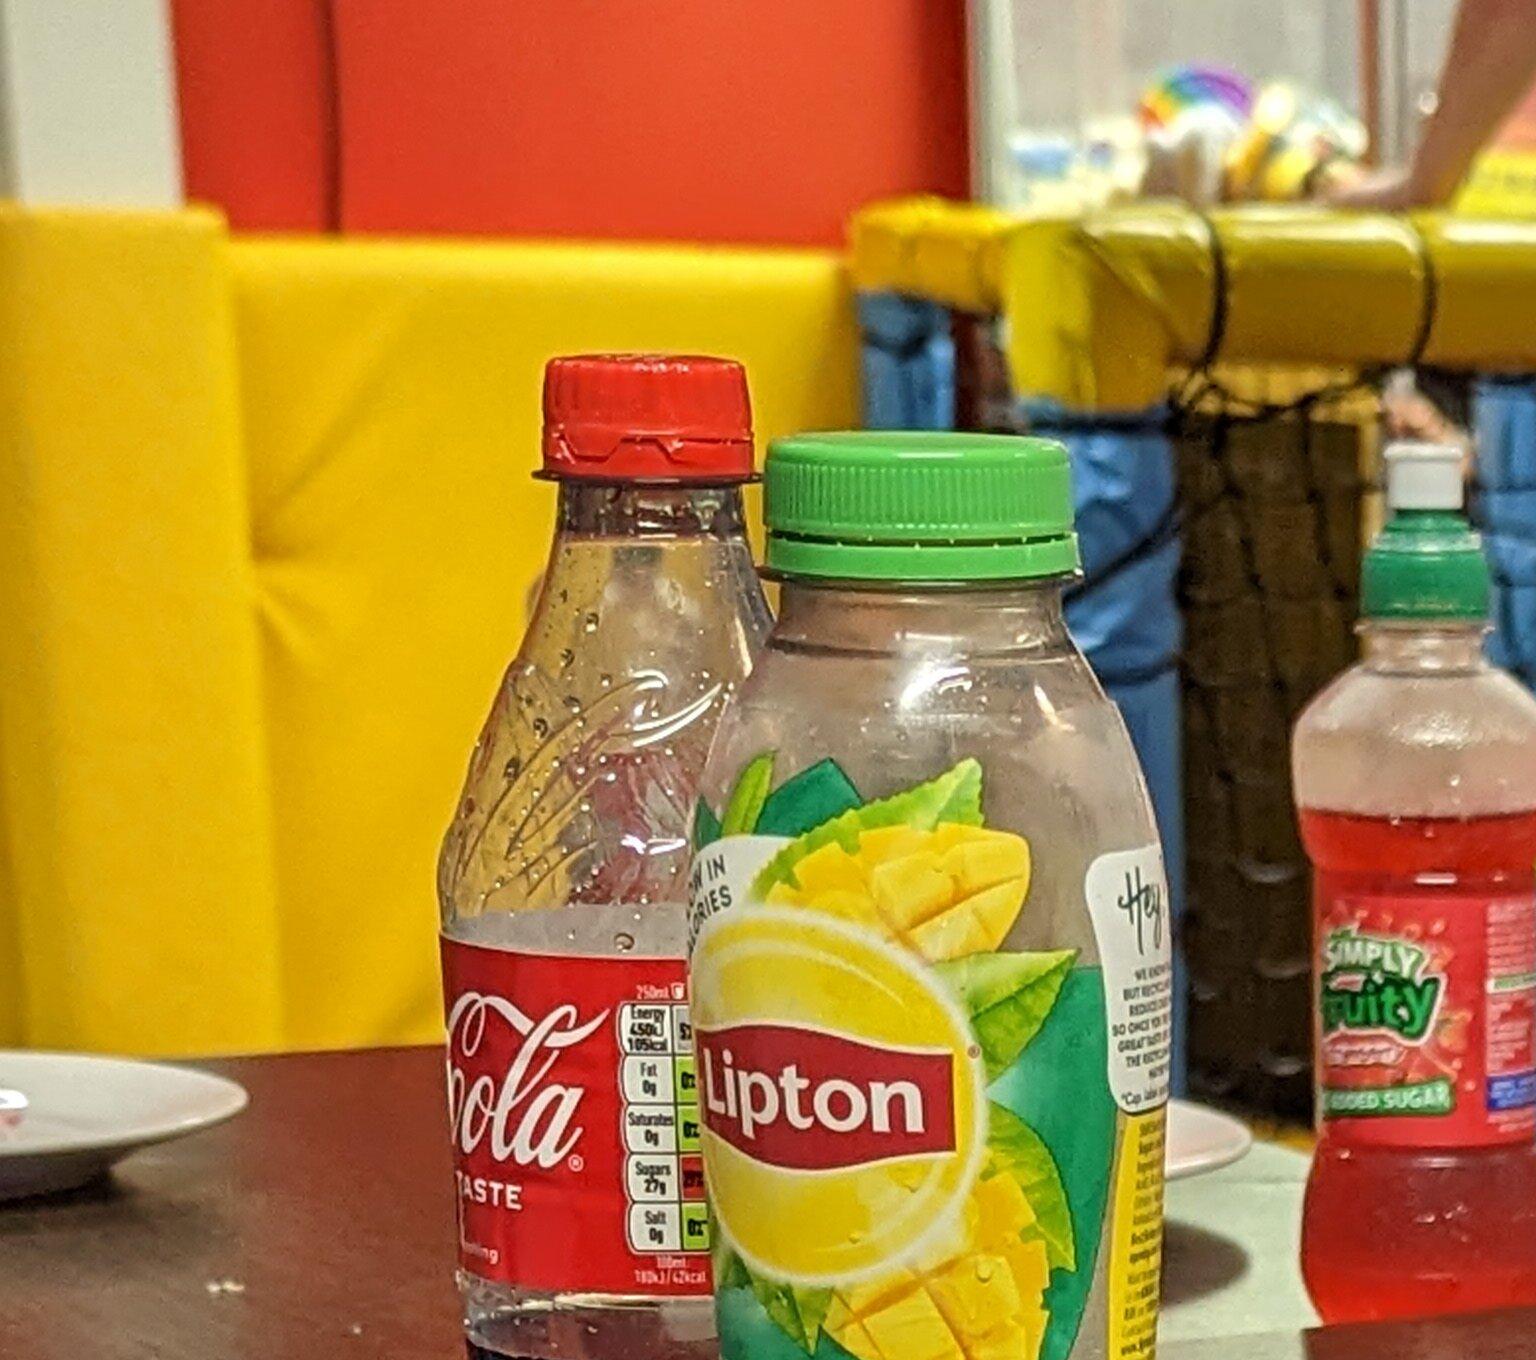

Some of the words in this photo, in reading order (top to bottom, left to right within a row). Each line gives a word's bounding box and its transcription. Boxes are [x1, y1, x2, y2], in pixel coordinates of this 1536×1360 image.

[706, 853, 726, 882] IN
[630, 1003, 666, 1024] Energy
[640, 1062, 658, 1078] Fat
[642, 1080, 657, 1097] 0g
[703, 1048, 926, 1141] Lipton
[644, 1129, 659, 1147] 0g
[635, 1160, 672, 1179] Sugars
[644, 1210, 667, 1225] Salt
[649, 1228, 664, 1245] 0g
